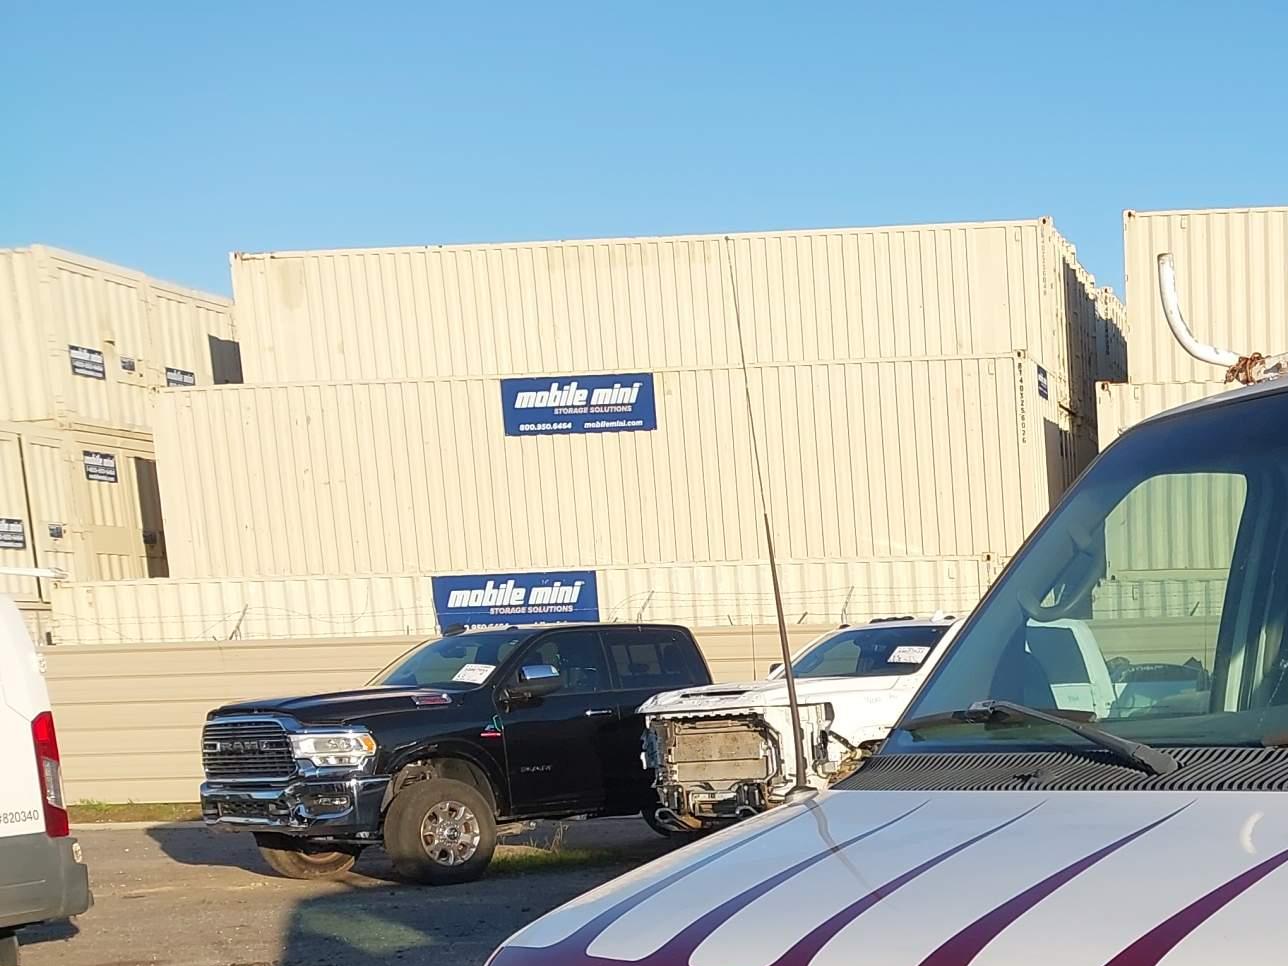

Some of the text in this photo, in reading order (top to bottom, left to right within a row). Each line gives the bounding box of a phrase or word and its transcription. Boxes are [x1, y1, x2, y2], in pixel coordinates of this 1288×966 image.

[514, 381, 640, 409] mobile mini
[553, 405, 633, 415] STORAGE SOLUTIONS
[584, 419, 644, 429] mobilemini.com
[447, 579, 584, 608] mobile mini
[489, 604, 573, 615] STORAGE SOLUTIONS
[0, 809, 40, 824] 820340
